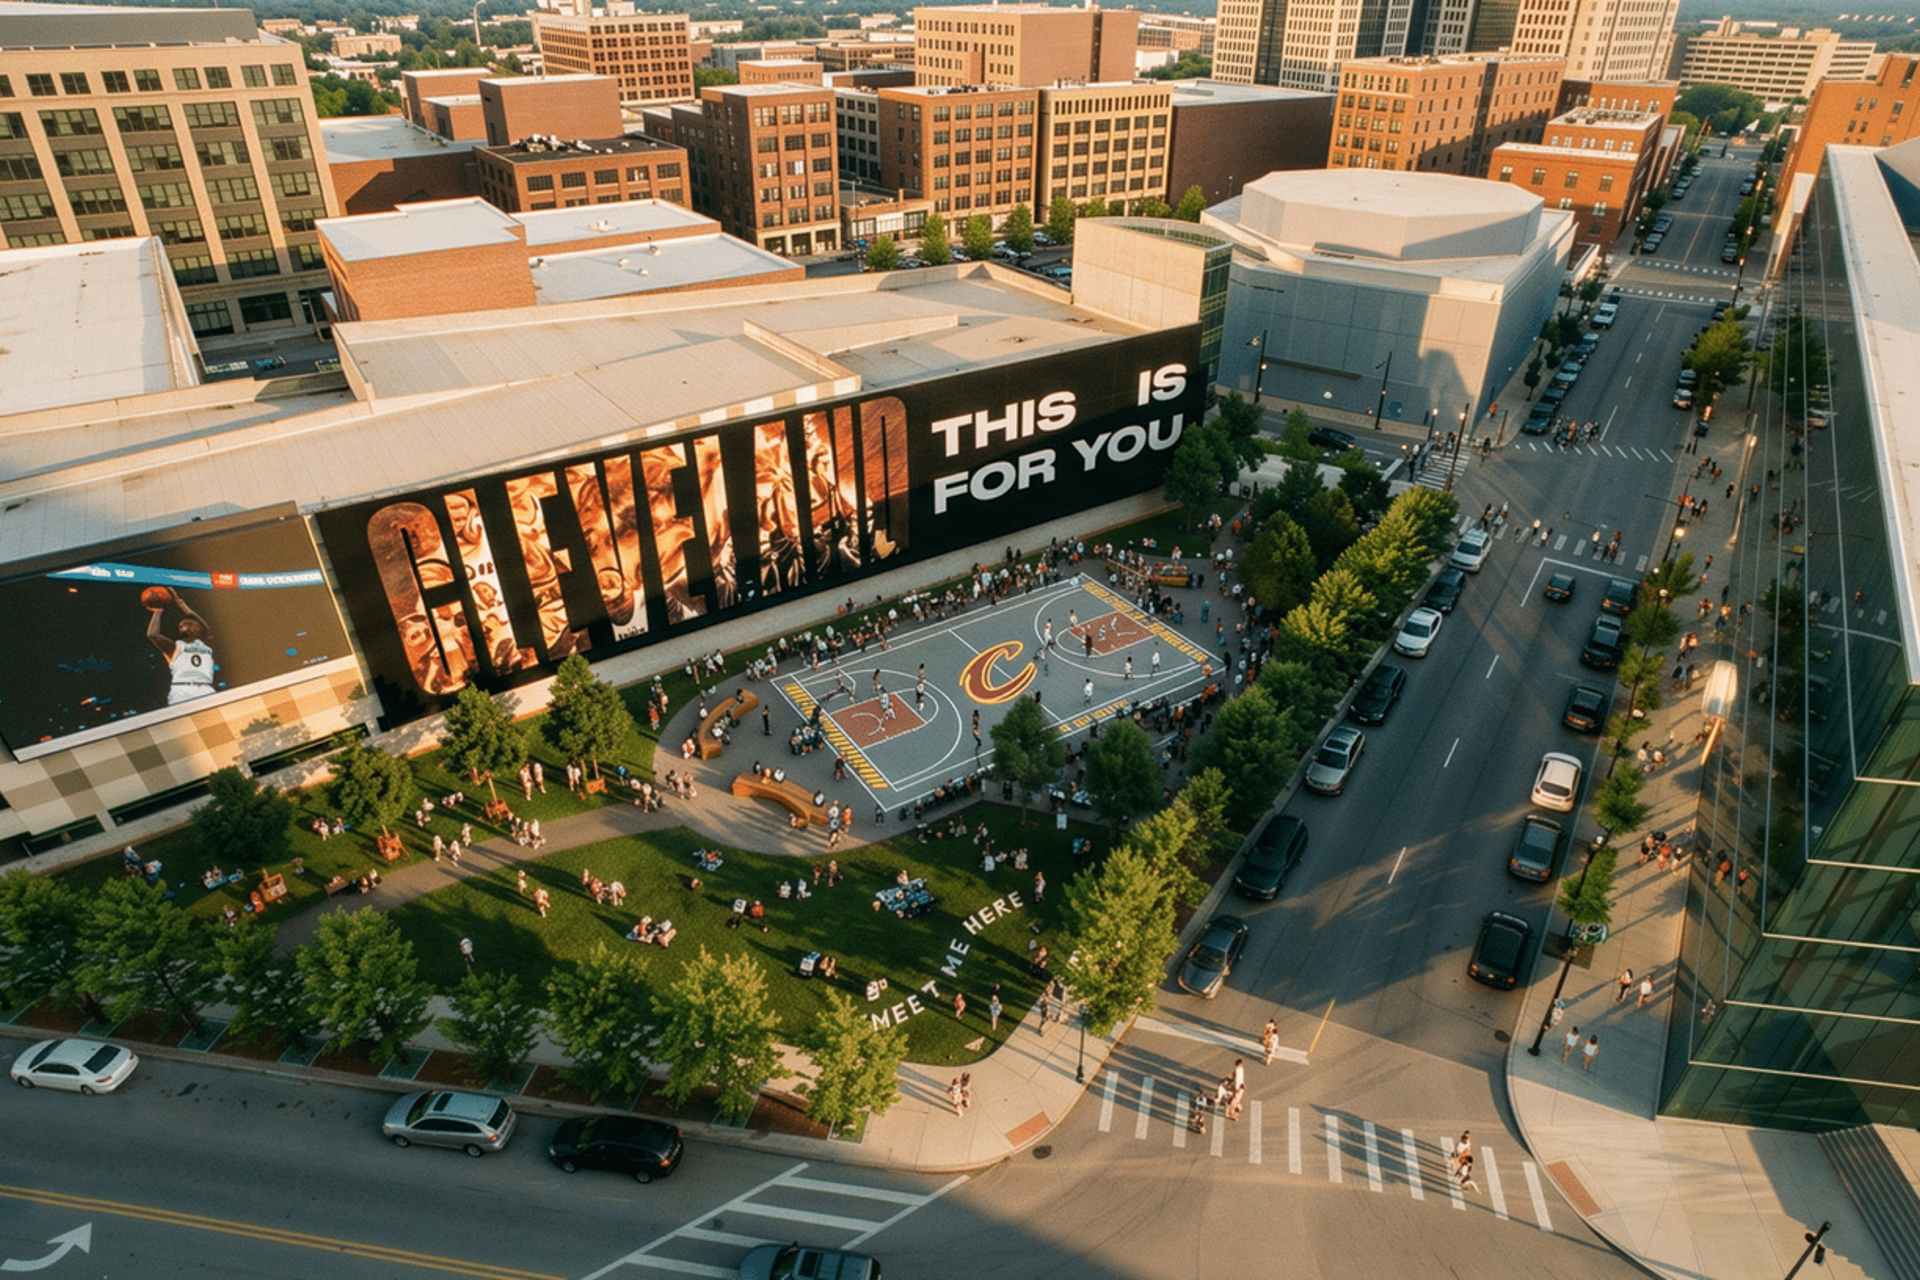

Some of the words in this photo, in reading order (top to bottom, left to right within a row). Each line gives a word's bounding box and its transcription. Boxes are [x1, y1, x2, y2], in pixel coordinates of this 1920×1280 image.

[931, 391, 1077, 458] THIS
[1137, 363, 1188, 407] IS
[934, 449, 1057, 515] FOR
[1072, 413, 1184, 471] YOU
[367, 396, 910, 695] CLEVELAND
[871, 980, 940, 1032] MEET
[940, 938, 970, 978] ME
[962, 890, 1024, 935] HERE
